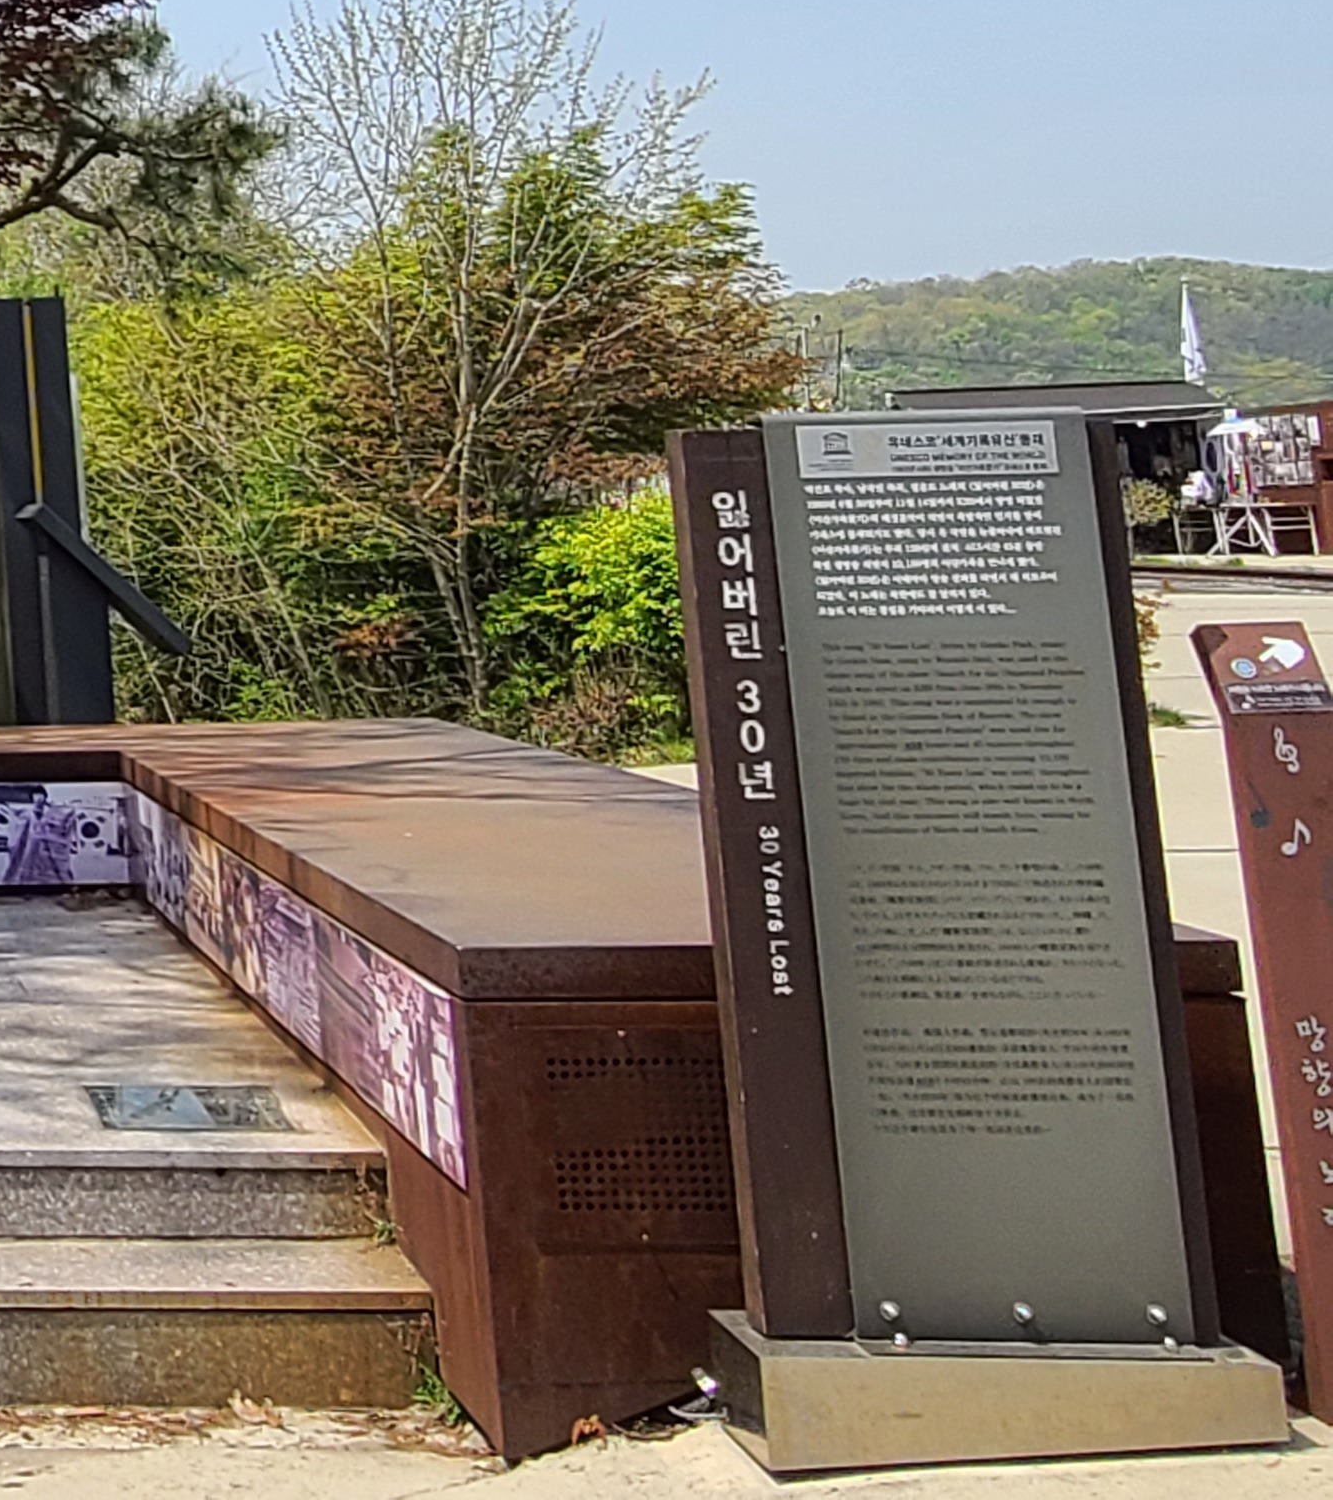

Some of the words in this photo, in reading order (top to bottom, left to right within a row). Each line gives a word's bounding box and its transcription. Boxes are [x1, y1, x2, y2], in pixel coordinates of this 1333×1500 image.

[712, 490, 763, 659] 잃어버린
[736, 680, 776, 800] 30년
[758, 825, 780, 854] 30
[762, 860, 785, 932] Years
[769, 940, 794, 996] Lost
